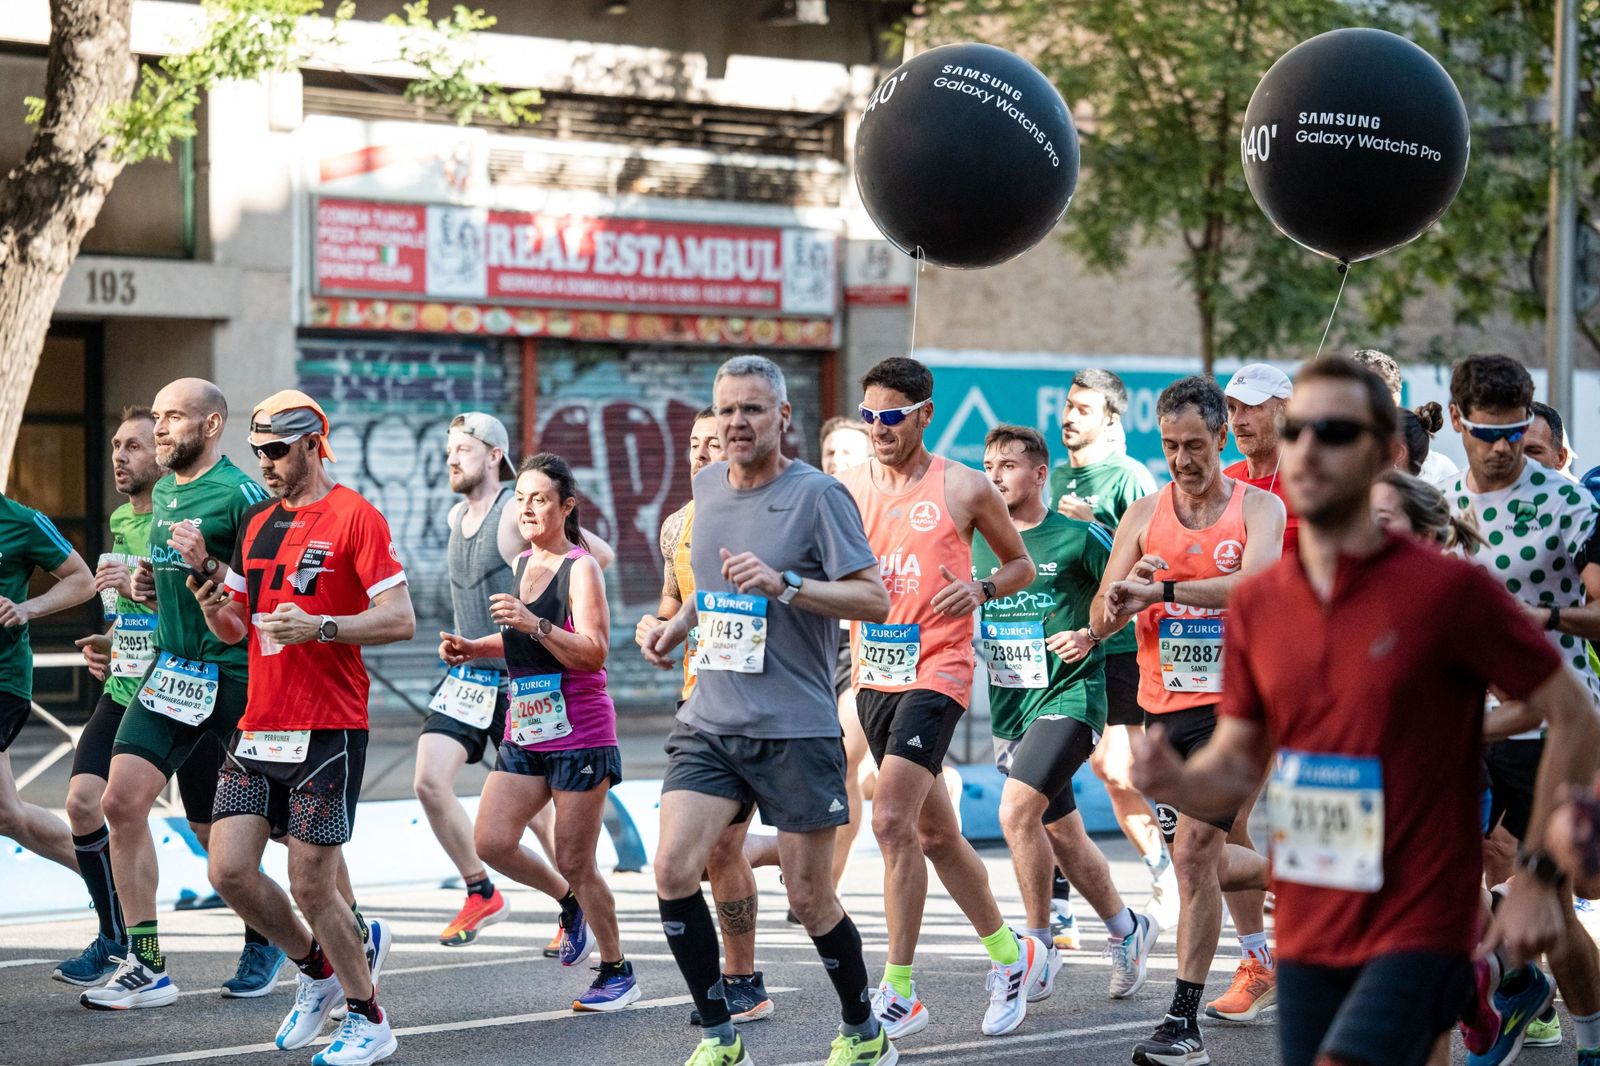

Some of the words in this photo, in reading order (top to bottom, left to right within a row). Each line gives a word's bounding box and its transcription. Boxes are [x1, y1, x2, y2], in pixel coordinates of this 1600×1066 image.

[942, 65, 1022, 101] SAMSUNG
[934, 77, 994, 104] Galaxy
[996, 96, 1046, 144] Watch5
[1044, 141, 1060, 168] Pro
[1298, 112, 1381, 130] SAMSUNG
[1296, 130, 1355, 149] Galaxy
[1358, 134, 1418, 157] Watch5
[1420, 145, 1442, 162] Pro
[487, 222, 590, 273] REAL
[592, 231, 783, 281] ESTAMBUL
[86, 270, 136, 305] 193
[879, 546, 922, 577] UÍA
[883, 578, 920, 595] CER
[716, 598, 753, 611] ZURICH
[124, 618, 149, 626] ZURICH
[710, 619, 744, 640] 1943
[1000, 627, 1032, 635] ZURICH
[1187, 625, 1226, 634] ZURICH
[871, 628, 907, 638] ZURICH
[118, 635, 148, 651] 23051
[864, 645, 906, 665] 22752
[991, 645, 1032, 662] 23844
[1172, 645, 1224, 663] 22887
[158, 676, 204, 700] 21966
[520, 680, 551, 691] ZURICH
[456, 686, 484, 704] 1546
